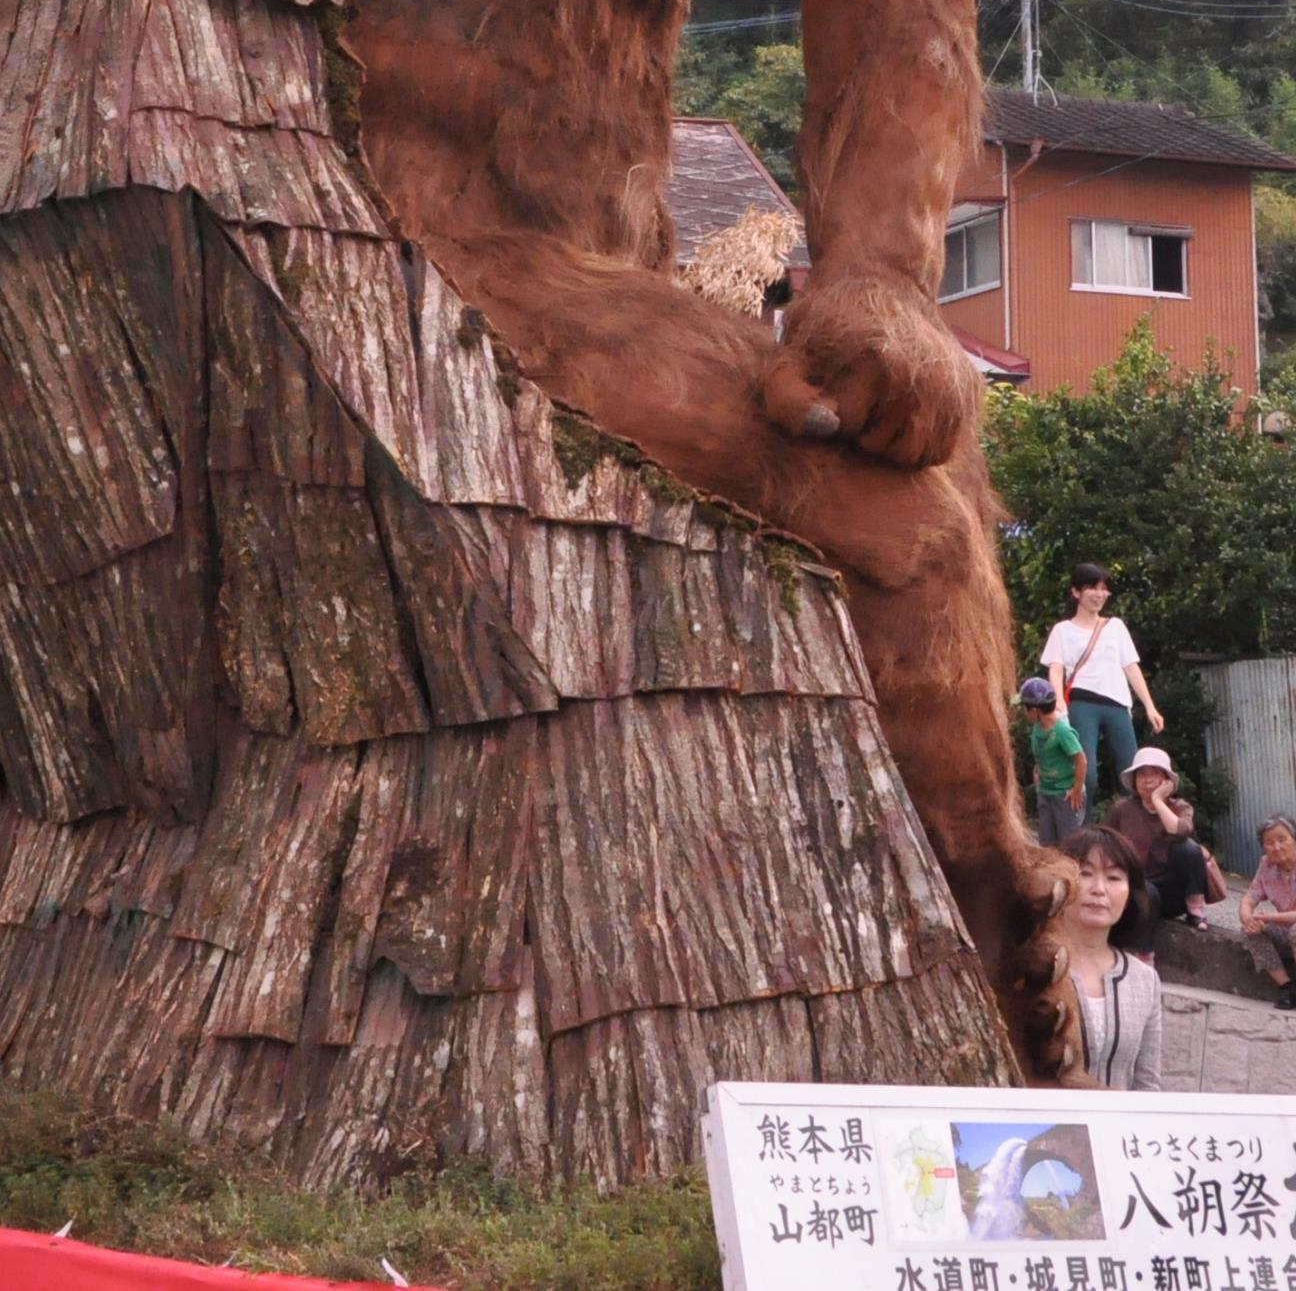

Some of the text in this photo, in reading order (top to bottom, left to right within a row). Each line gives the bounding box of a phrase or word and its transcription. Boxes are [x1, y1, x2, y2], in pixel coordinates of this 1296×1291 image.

[756, 1113, 873, 1164] 熊本県
[1121, 1133, 1264, 1163] はっさくまつり
[769, 1174, 872, 1196] やまとちょう
[768, 1199, 879, 1249] 山都町
